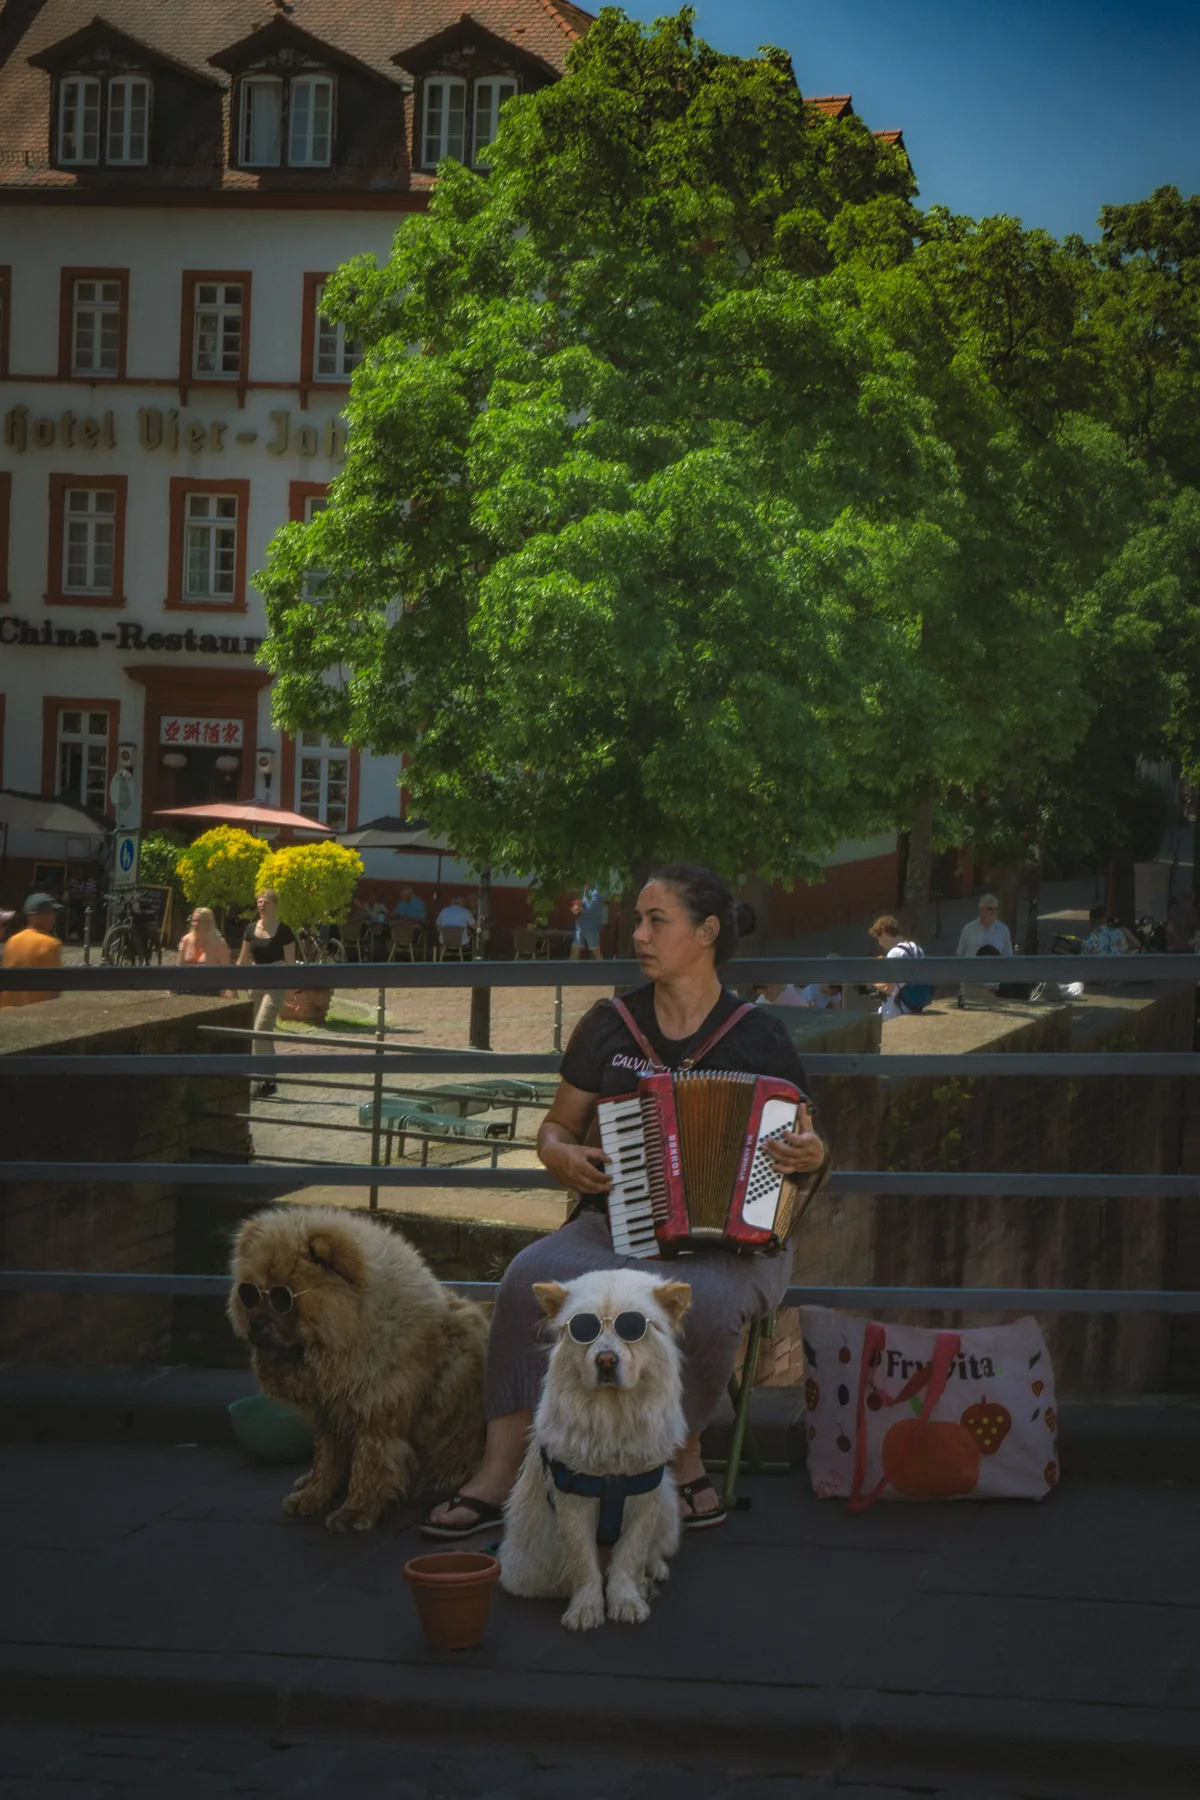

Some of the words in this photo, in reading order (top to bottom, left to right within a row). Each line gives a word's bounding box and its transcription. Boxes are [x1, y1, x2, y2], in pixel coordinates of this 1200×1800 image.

[4, 404, 117, 453] Hotel
[138, 408, 347, 463] Vier-Jah
[0, 616, 263, 655] China-Restaur
